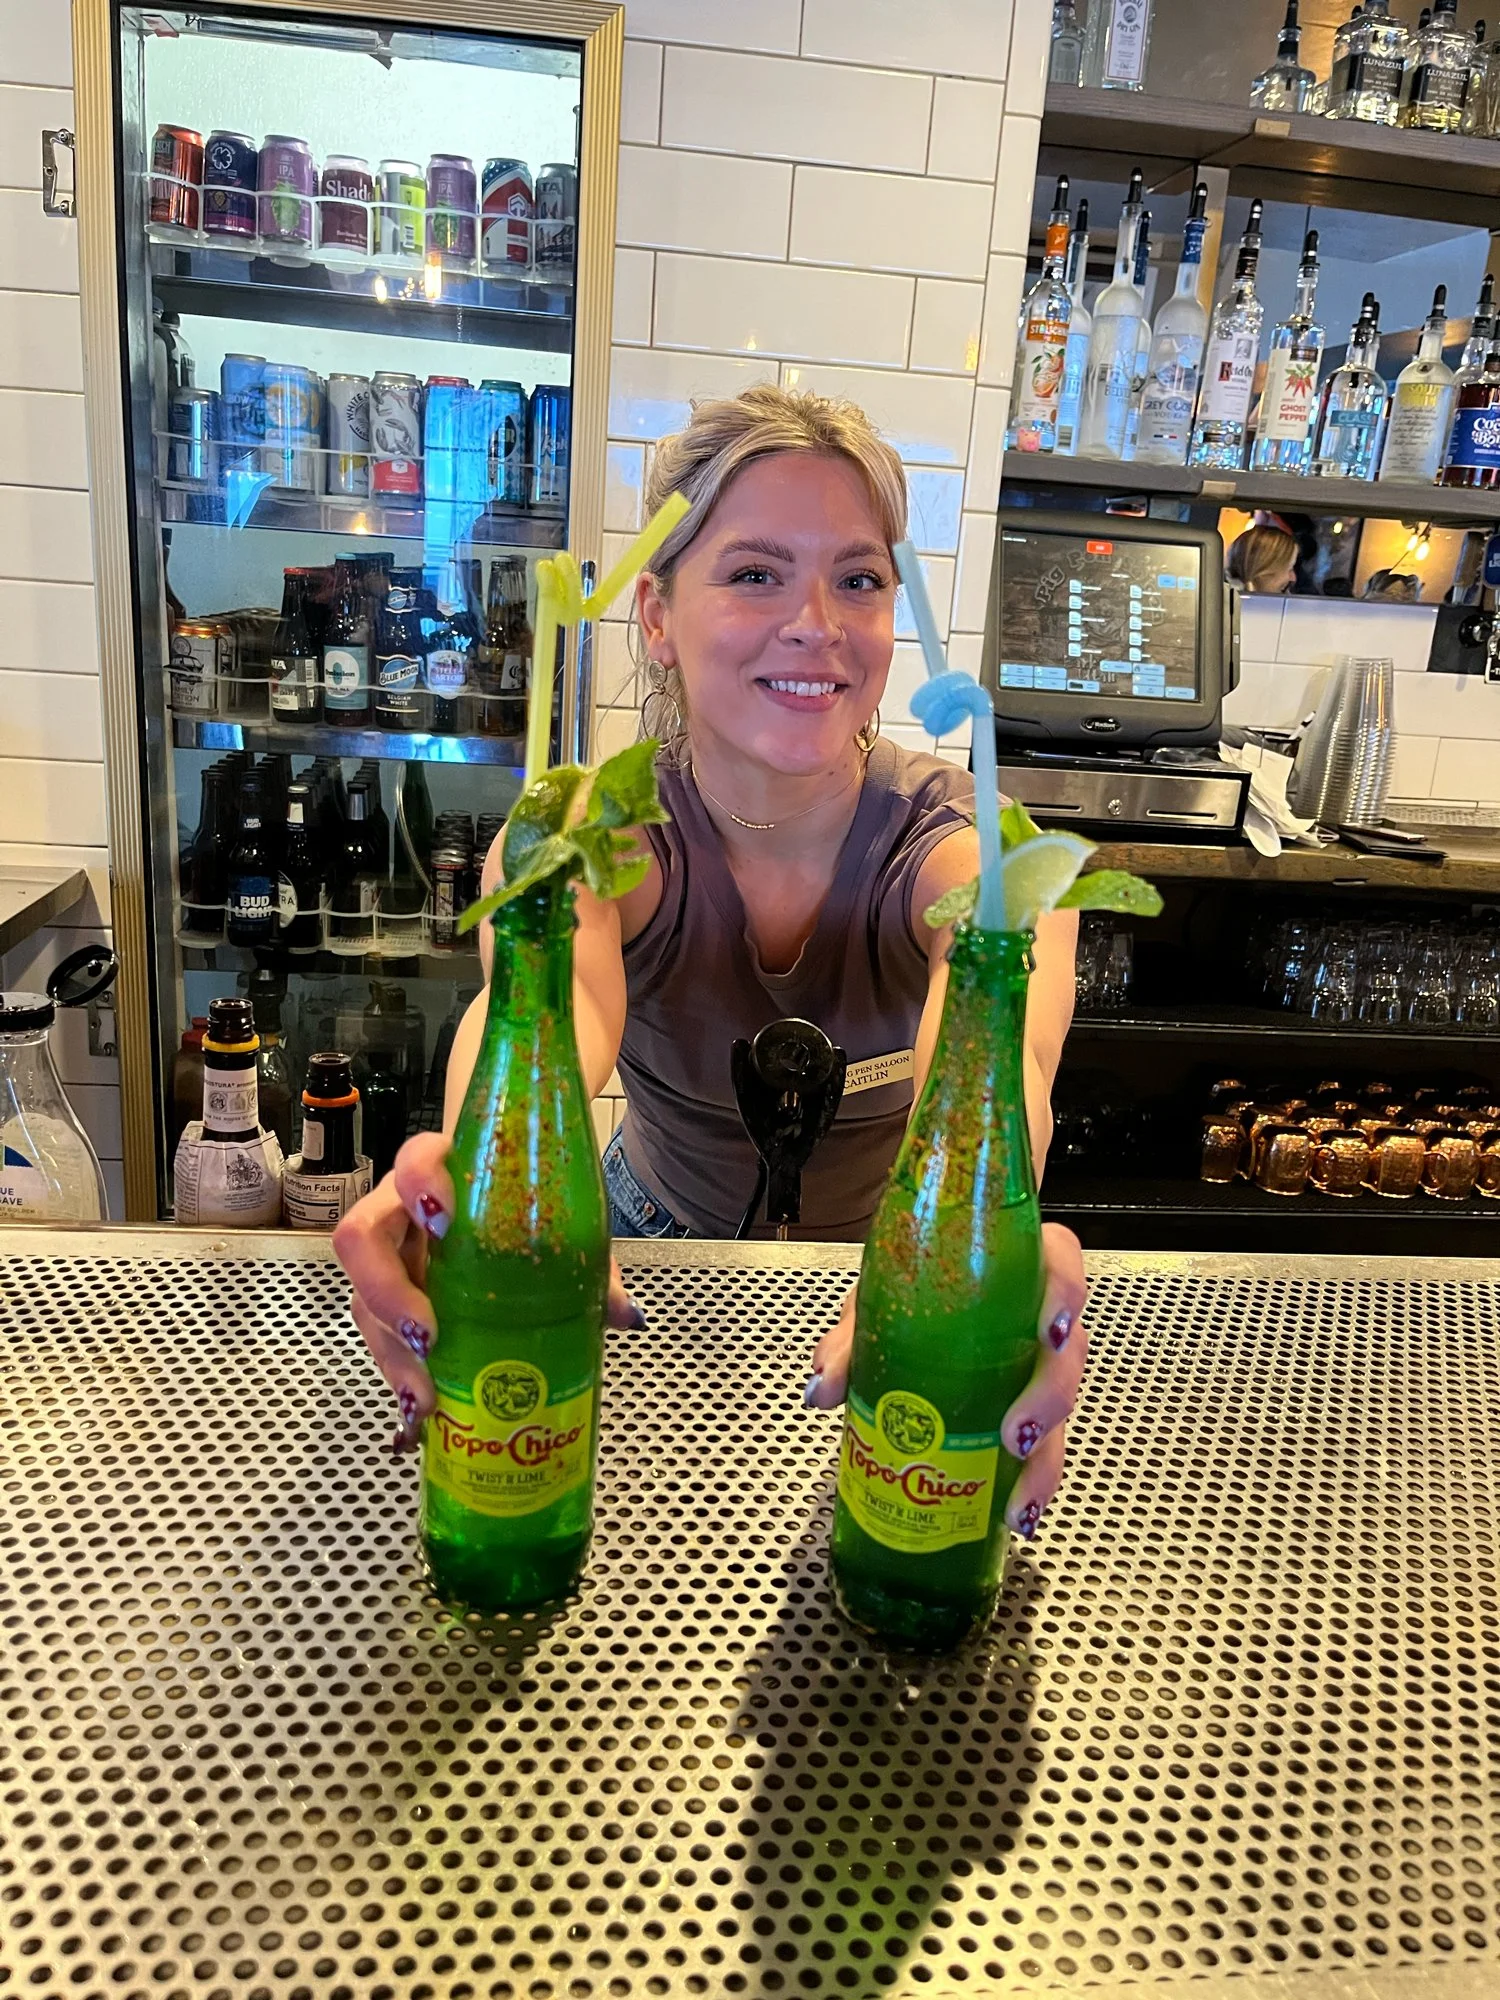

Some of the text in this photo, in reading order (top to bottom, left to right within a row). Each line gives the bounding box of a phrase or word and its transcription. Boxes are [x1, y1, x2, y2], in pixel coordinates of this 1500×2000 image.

[1363, 58, 1402, 70] LUNAZUL
[1427, 69, 1468, 81] LUNAZUL
[279, 165, 294, 177] IPA
[438, 183, 453, 195] IPA
[346, 393, 363, 421] WHITE
[1280, 404, 1306, 412] GHOST
[381, 666, 418, 684] BLUE MOON
[240, 896, 270, 908] BUD
[234, 905, 272, 919] LIGHT
[855, 1065, 872, 1075] PEN
[874, 1056, 910, 1070] SALOON
[844, 1070, 888, 1088] CAITLIN
[285, 1176, 340, 1192] Nutrition Facts
[328, 1208, 339, 1219] 5
[435, 1410, 586, 1466] Topo Chico
[847, 1425, 987, 1506] Topo Chico
[467, 1470, 504, 1484] TWIST
[517, 1470, 546, 1484] LIME
[864, 1491, 897, 1516] TWIST
[907, 1509, 937, 1525] LIME
